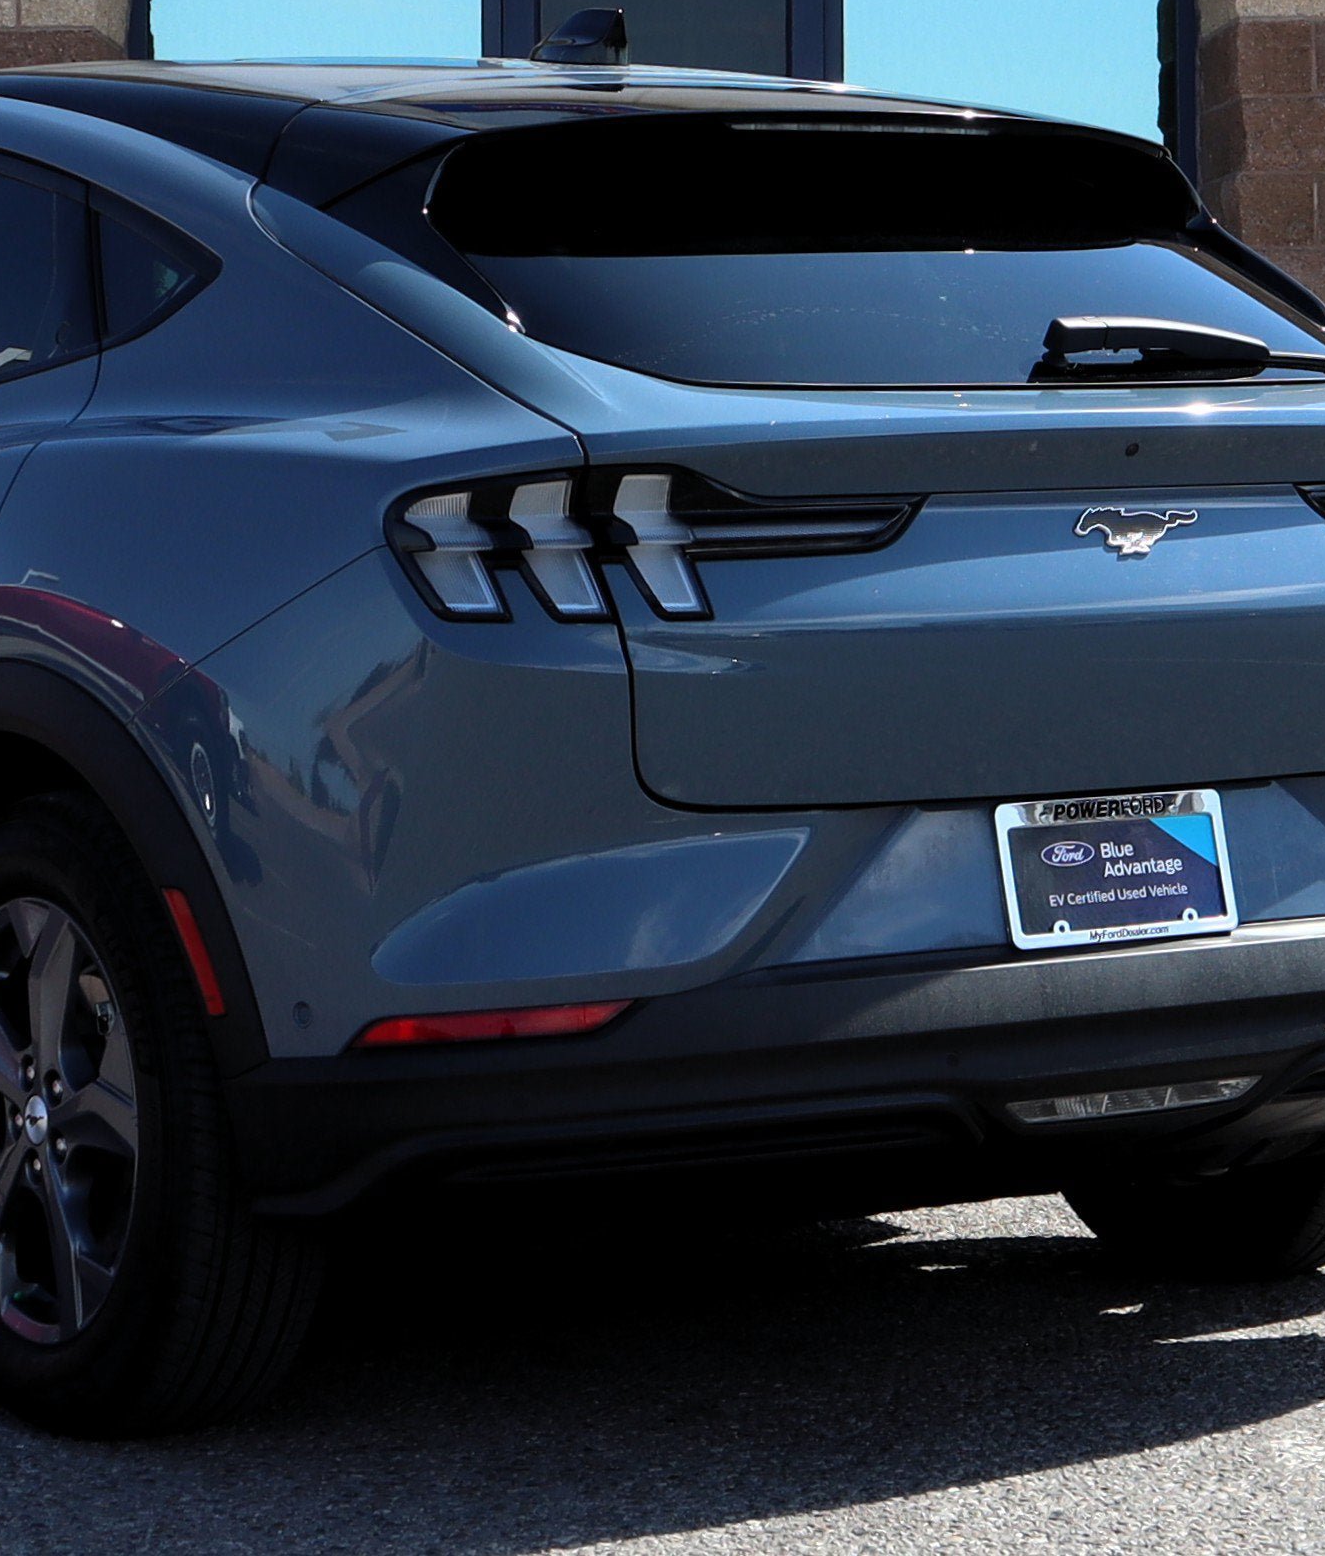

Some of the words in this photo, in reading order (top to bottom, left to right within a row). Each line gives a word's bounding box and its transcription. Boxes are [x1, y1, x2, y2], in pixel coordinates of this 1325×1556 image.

[1053, 796, 1166, 821] POWERFORD
[1051, 845, 1085, 863] Ford
[1100, 841, 1134, 859] Blue
[1104, 857, 1183, 878] Advantage
[1049, 894, 1065, 907] EV
[1067, 889, 1115, 905] Certified
[1117, 886, 1147, 900] Used
[1148, 882, 1188, 897] Vehicle
